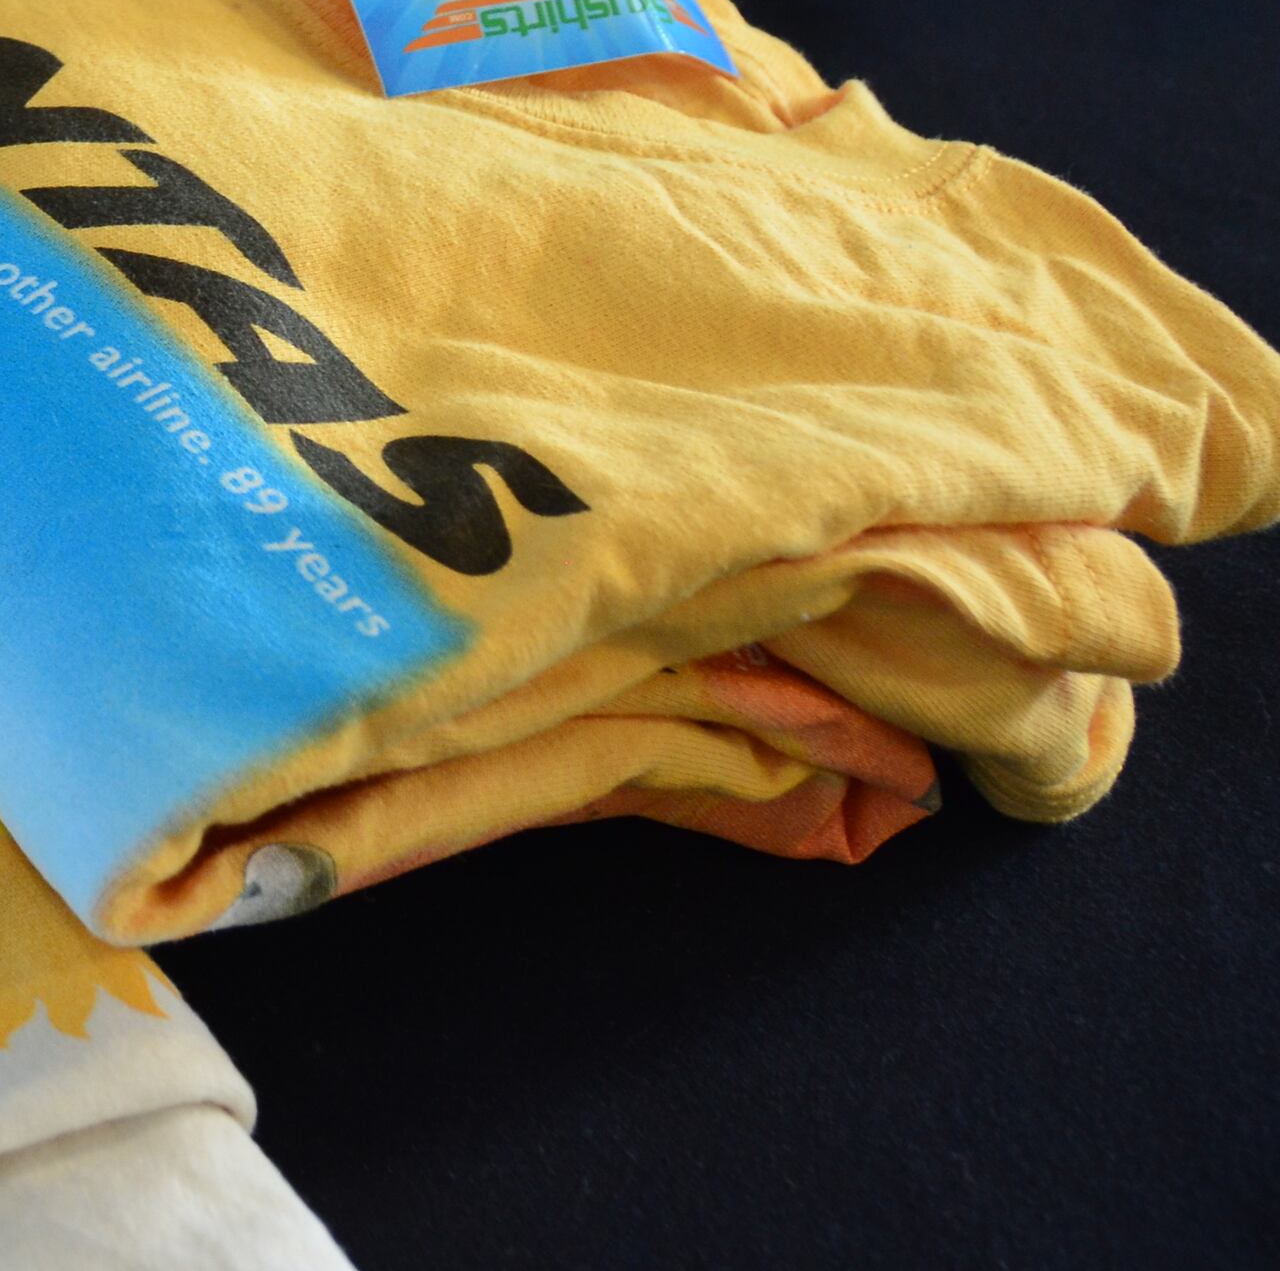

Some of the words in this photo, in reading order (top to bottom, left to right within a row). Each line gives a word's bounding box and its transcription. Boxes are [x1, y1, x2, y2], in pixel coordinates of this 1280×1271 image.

[88, 342, 212, 466] airline.
[218, 464, 289, 515] 89
[262, 525, 390, 639] years
